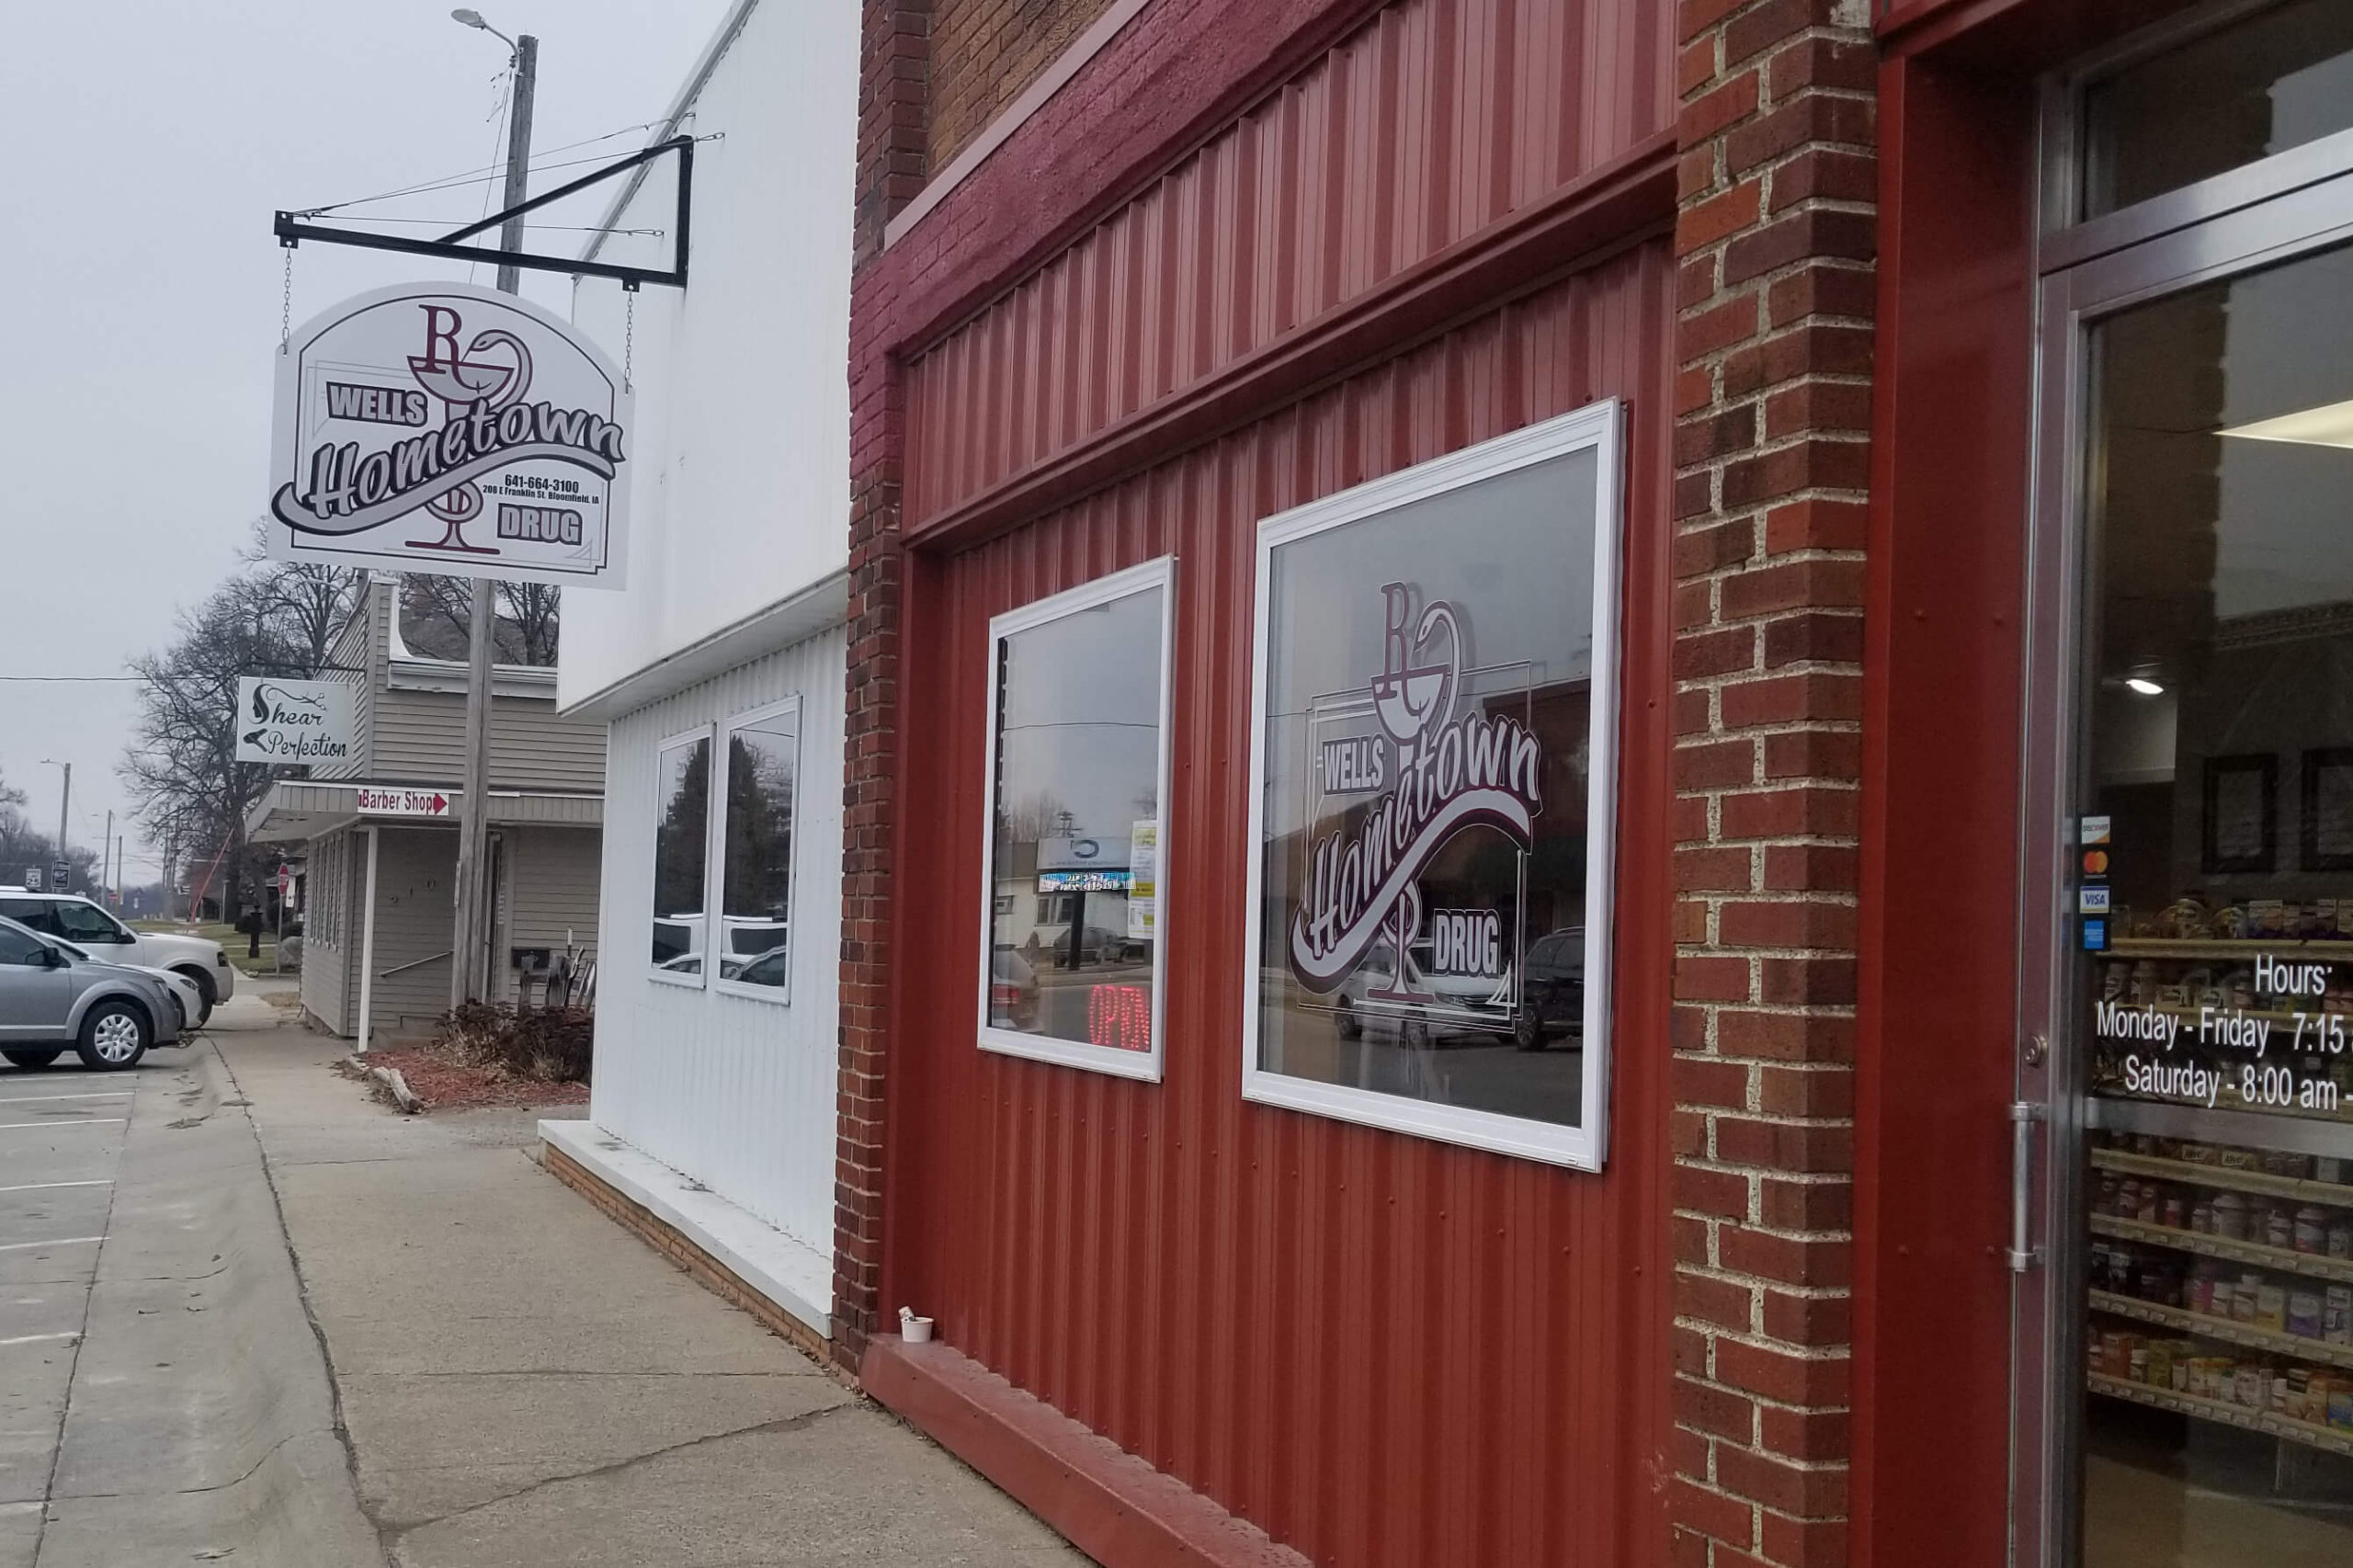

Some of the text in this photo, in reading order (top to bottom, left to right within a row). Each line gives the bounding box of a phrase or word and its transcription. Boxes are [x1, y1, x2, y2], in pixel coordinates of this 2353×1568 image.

[327, 382, 426, 426] WELLS
[306, 397, 626, 519] Hometown
[499, 487, 504, 495] E
[505, 487, 535, 498] Franklin
[592, 496, 599, 505] IA
[505, 474, 579, 494] 641-664-3100
[499, 505, 581, 544] DRUG
[248, 684, 324, 726] Shear
[268, 730, 348, 761] Perfection
[1324, 734, 1384, 793] WELLS
[361, 790, 434, 814] Barber Shop
[1310, 713, 1541, 958] Hometown
[2086, 894, 2106, 905] VISA
[1435, 910, 1500, 975] DRUG
[1088, 985, 1150, 1051] OPEN
[2097, 1001, 2178, 1051] Monday
[2200, 1007, 2270, 1057] Friday
[2291, 1013, 2345, 1053] 7:15
[2125, 1055, 2220, 1108] Saturday
[2243, 1065, 2292, 1106] 8:00
[2301, 1078, 2337, 1110] am
